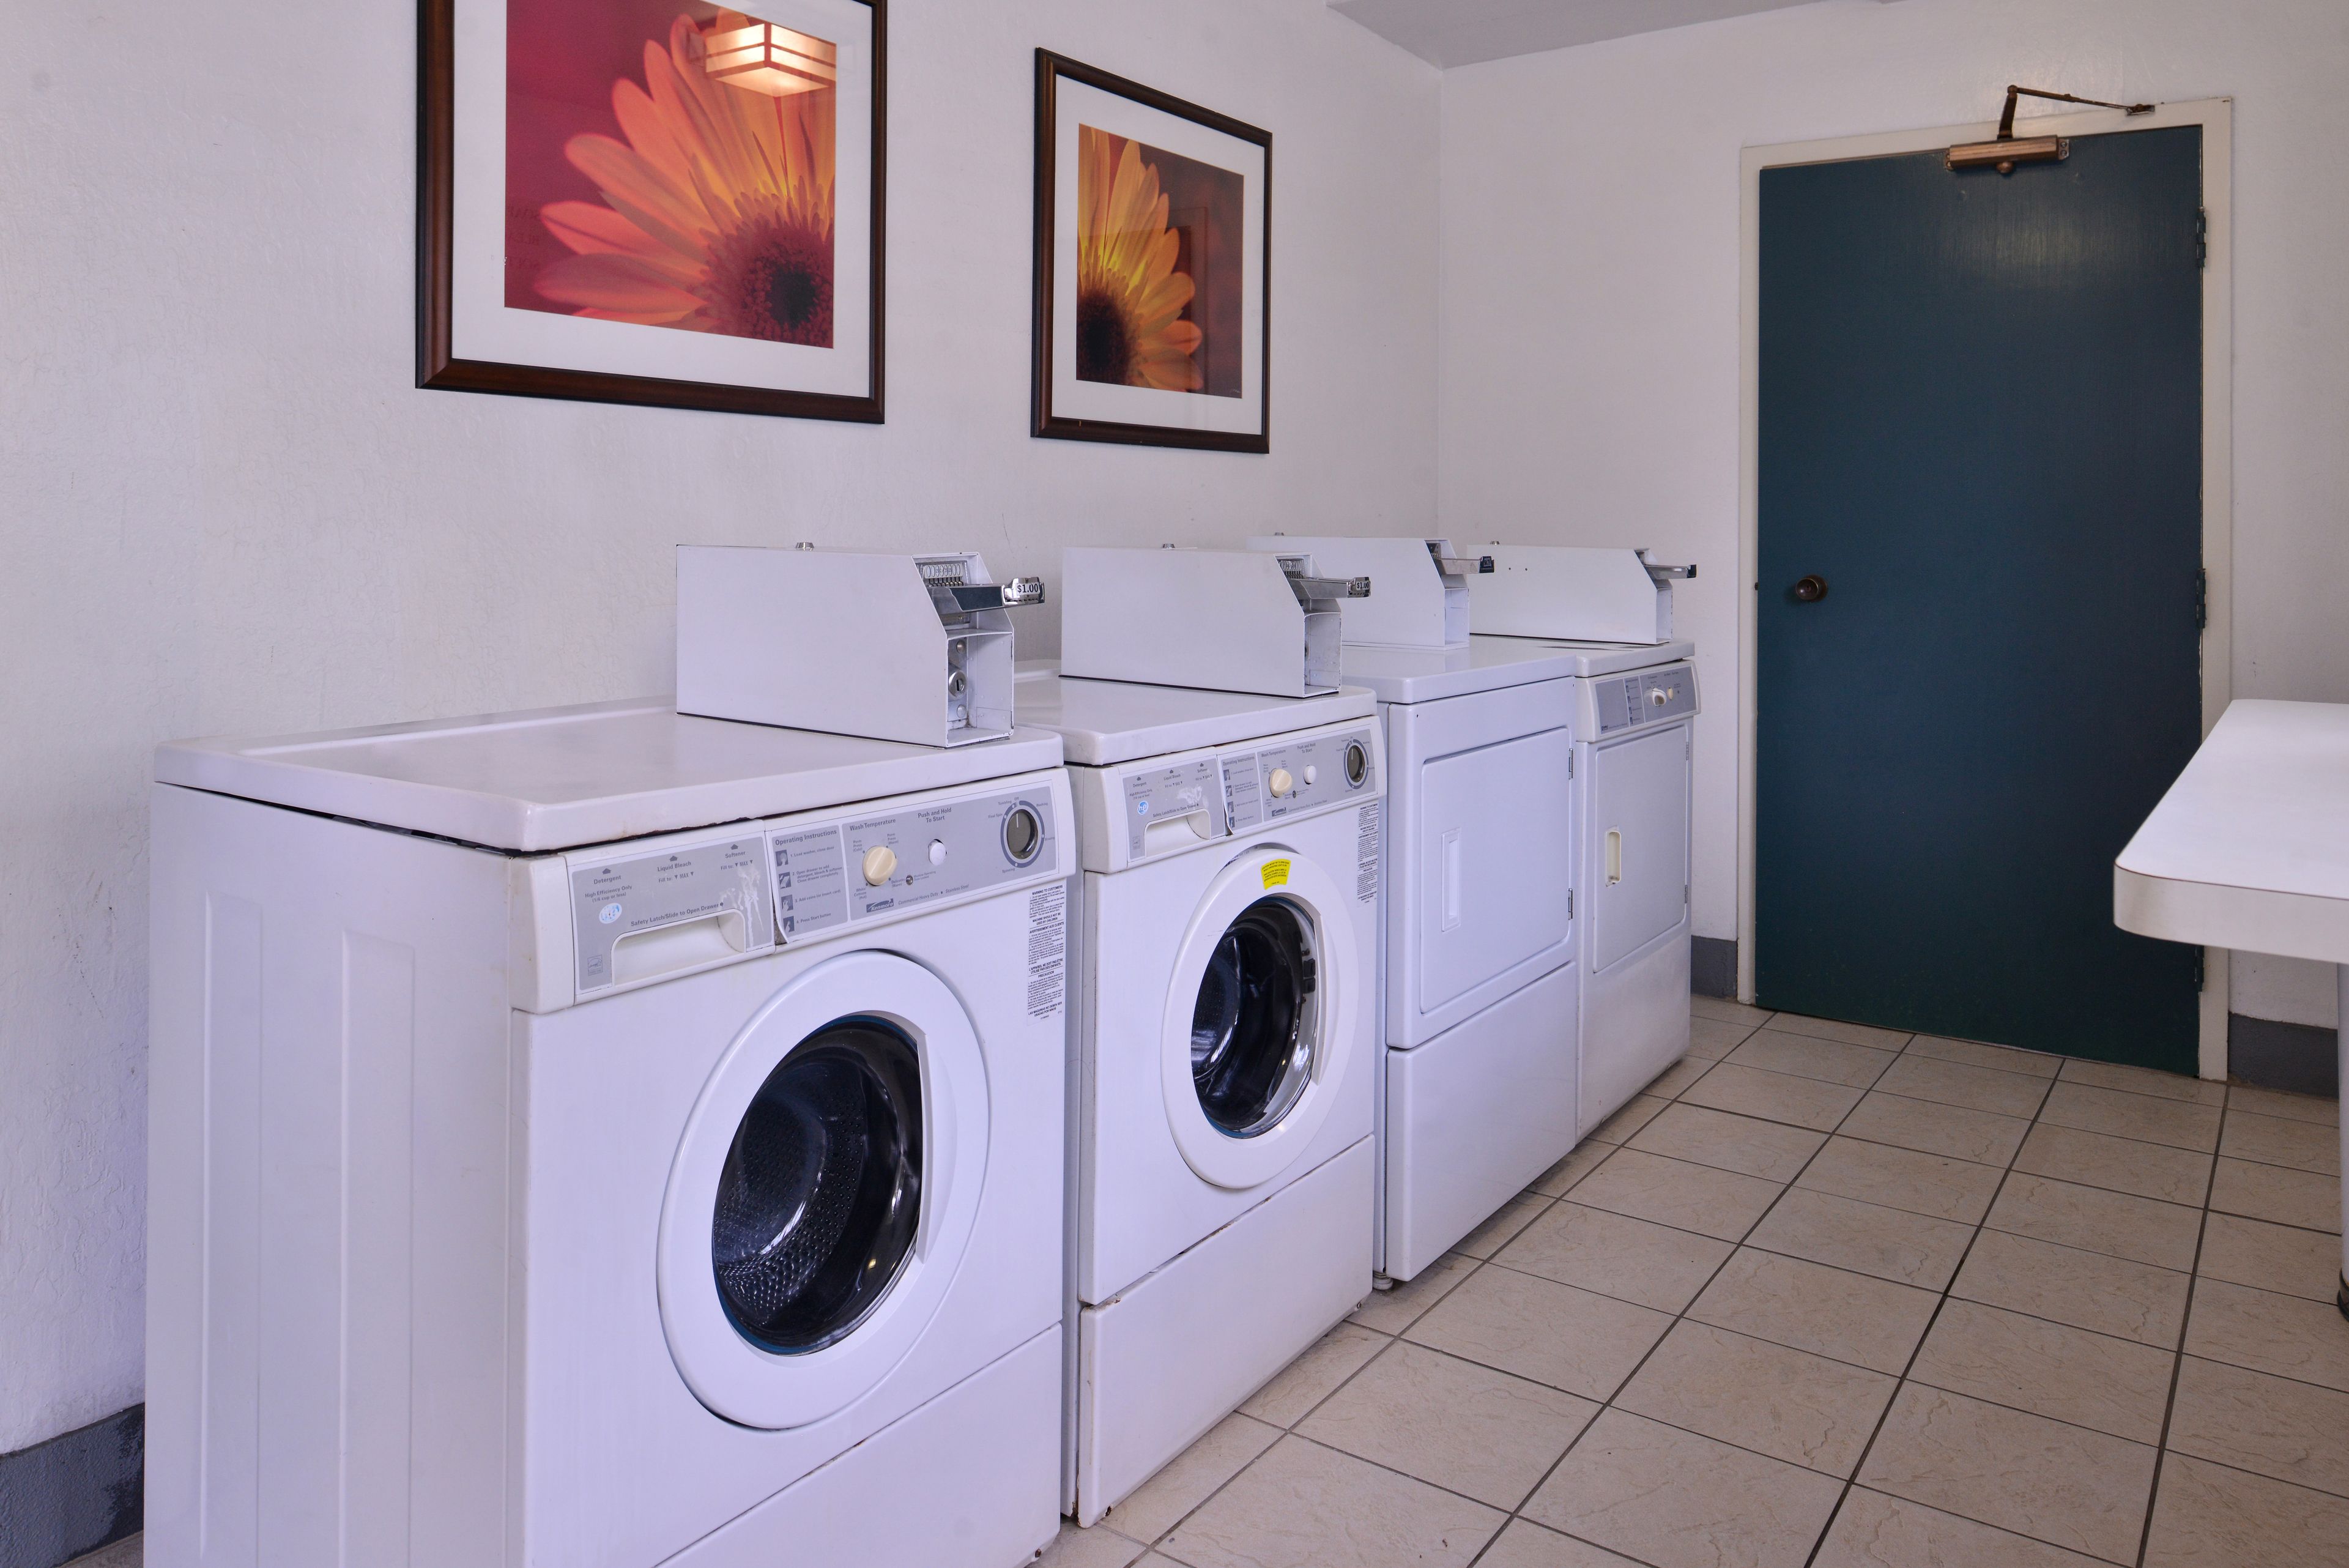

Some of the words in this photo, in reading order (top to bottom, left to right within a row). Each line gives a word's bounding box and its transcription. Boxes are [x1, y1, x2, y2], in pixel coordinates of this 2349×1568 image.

[1017, 583, 1039, 593] $1.00
[864, 818, 896, 828] Temperature
[775, 836, 803, 846] Operating
[804, 830, 837, 840] Instructions
[657, 864, 674, 872] Liquid
[593, 875, 622, 885] Detergent
[596, 887, 620, 896] Efficiency
[870, 902, 893, 912] Kenmore
[898, 896, 919, 905] Commercial
[650, 912, 678, 923] Latch/Slide
